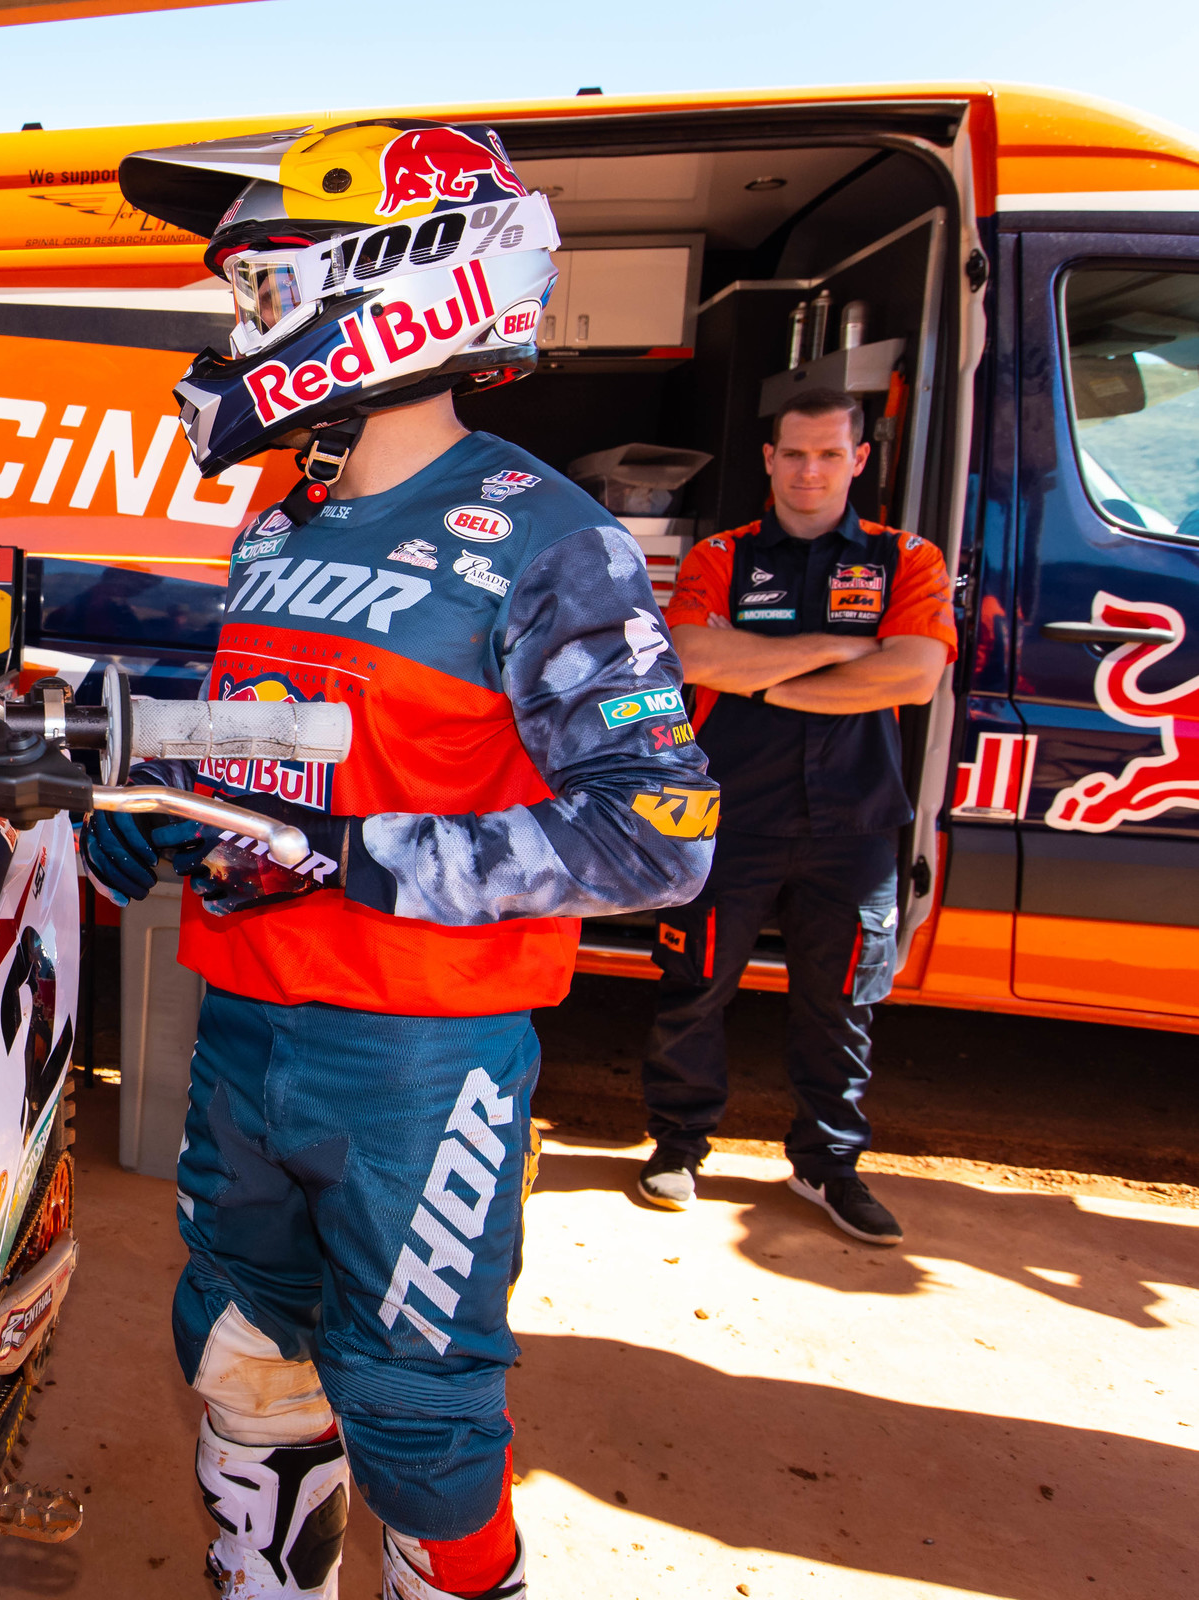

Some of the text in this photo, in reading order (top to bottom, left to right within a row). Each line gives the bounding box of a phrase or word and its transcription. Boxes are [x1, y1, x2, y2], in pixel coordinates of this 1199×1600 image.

[28, 168, 119, 186] We suppor
[25, 236, 59, 247] SPINAL
[64, 235, 90, 246] CORD
[94, 234, 147, 245] RESEARCH
[320, 201, 524, 291] 100%
[503, 309, 537, 336] BELL
[250, 258, 495, 424] Red Bull
[319, 504, 353, 520] PULSE
[453, 512, 500, 536] BELL
[831, 576, 883, 590] Red Bull
[227, 557, 433, 634] THOR
[837, 594, 875, 606] KTM
[744, 608, 794, 620] MOTOREX
[830, 611, 857, 619] FACTORY
[291, 644, 378, 671] HALLMAN
[250, 758, 328, 811] Bull
[377, 1066, 513, 1358] THOR
